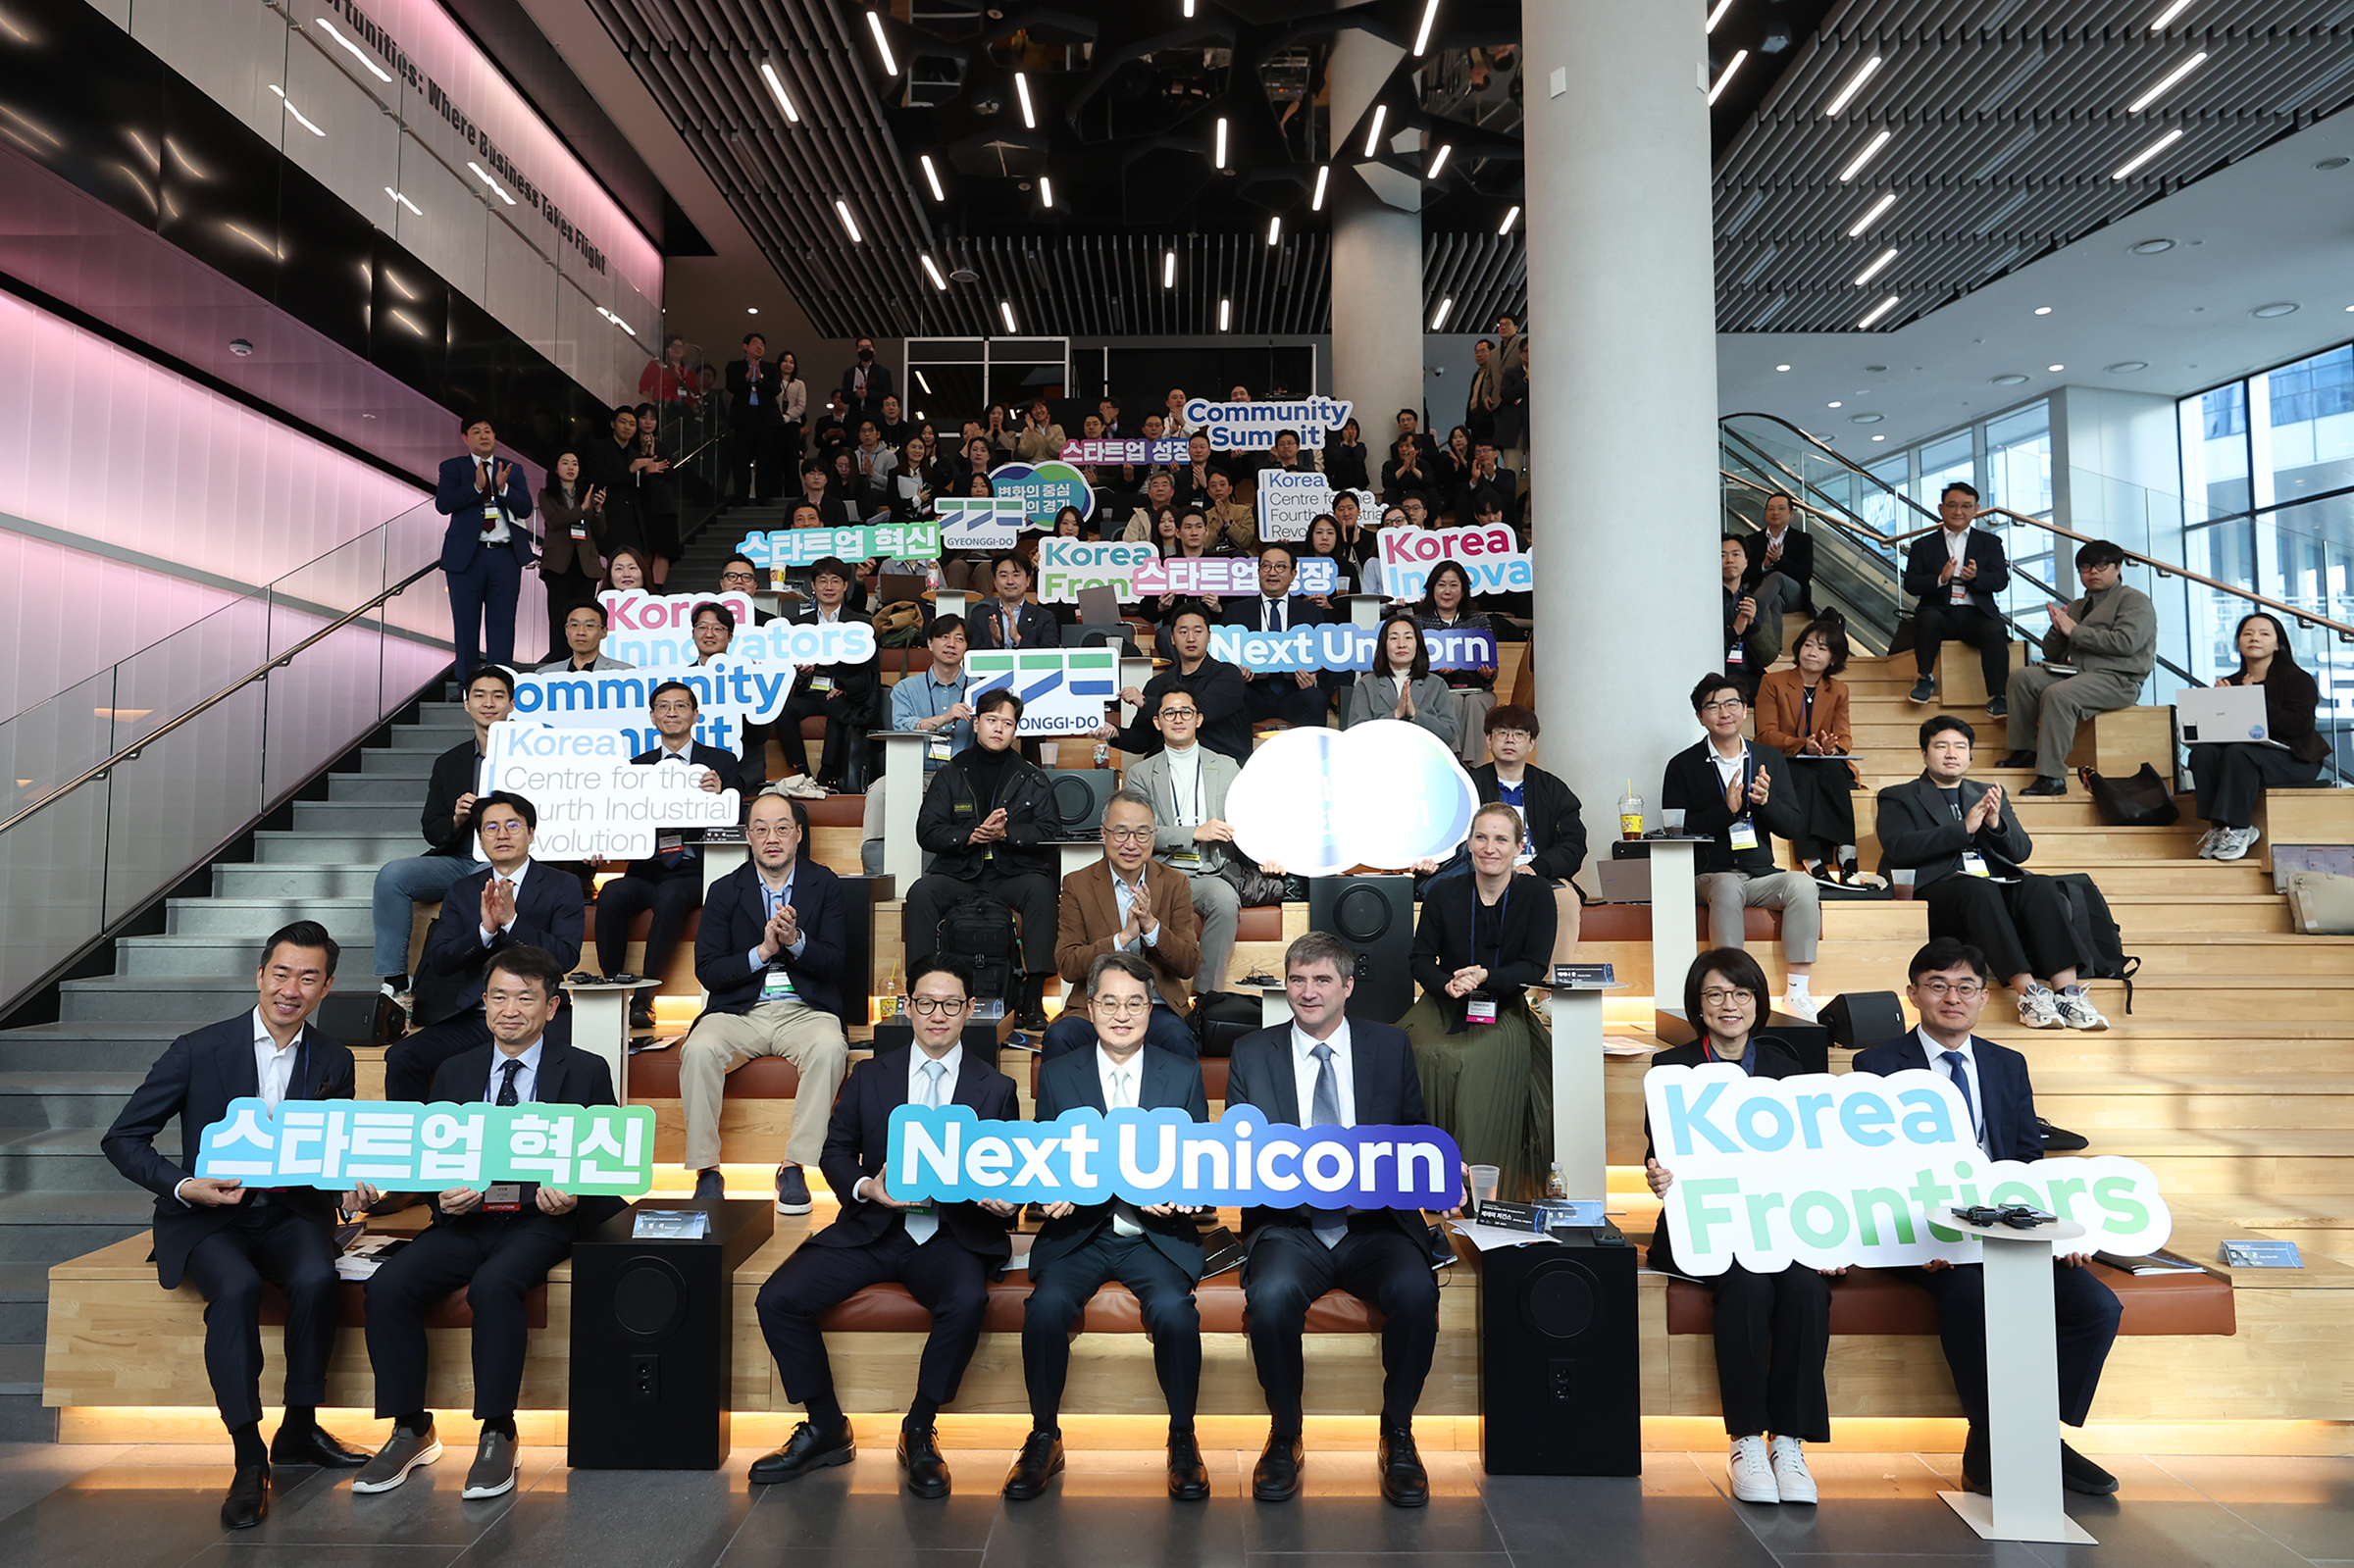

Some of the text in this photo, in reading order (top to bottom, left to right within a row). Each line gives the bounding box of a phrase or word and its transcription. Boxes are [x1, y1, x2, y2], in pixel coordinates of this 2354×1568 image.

[429, 76, 476, 145] Where
[479, 129, 538, 209] Business
[540, 193, 573, 243] Takes
[575, 228, 605, 276] Flight
[1188, 400, 1348, 426] Community
[1211, 425, 1320, 446] Sumit
[1062, 441, 1146, 462] 스타트업
[1043, 482, 1071, 497] 중심
[1269, 473, 1325, 487] Korea
[1269, 492, 1319, 506] Centre
[741, 526, 937, 563] 스타트업 혁신
[947, 537, 1014, 546] GYEONGGI-DO
[1046, 542, 1151, 567] Korea
[1385, 530, 1510, 565] Korea
[1138, 562, 1260, 591] 스타트업
[606, 597, 745, 632] Kora
[1210, 631, 1490, 664] Next Unorn
[1018, 716, 1100, 731] ONGGI-DO
[507, 729, 617, 756] Korea
[504, 765, 703, 790] Centre for the
[537, 796, 732, 822] urth Industrial
[1663, 1081, 1957, 1156] Korea
[206, 1109, 644, 1185] 스타트업 혁신
[900, 1120, 1446, 1192] Next Unicorn
